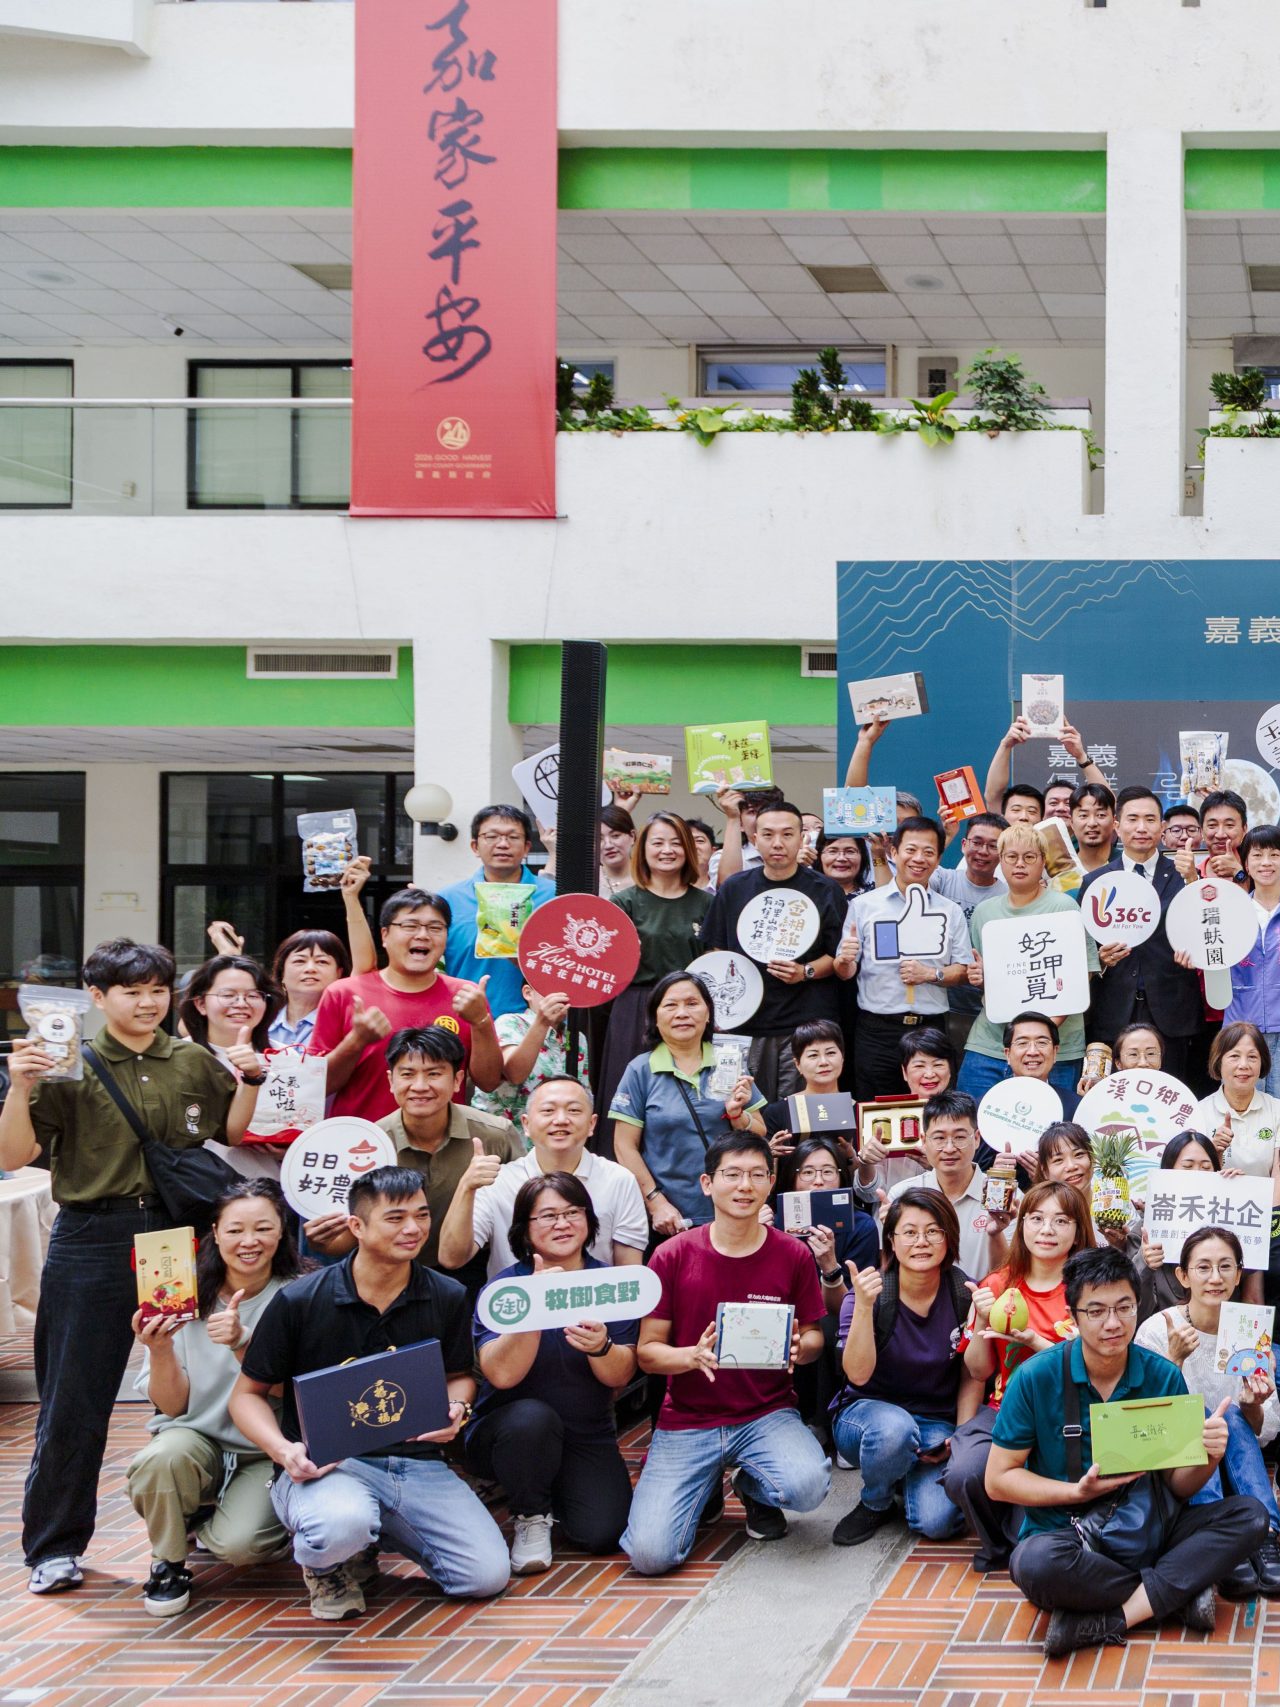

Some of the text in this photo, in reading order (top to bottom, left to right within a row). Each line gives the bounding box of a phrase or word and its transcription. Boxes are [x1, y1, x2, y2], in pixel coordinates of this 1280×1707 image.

[576, 964, 616, 983] HOTEL
[1107, 1078, 1195, 1130] 溪口鄉農
[303, 1152, 338, 1170] 日日
[1151, 1193, 1263, 1228] 崙禾社企
